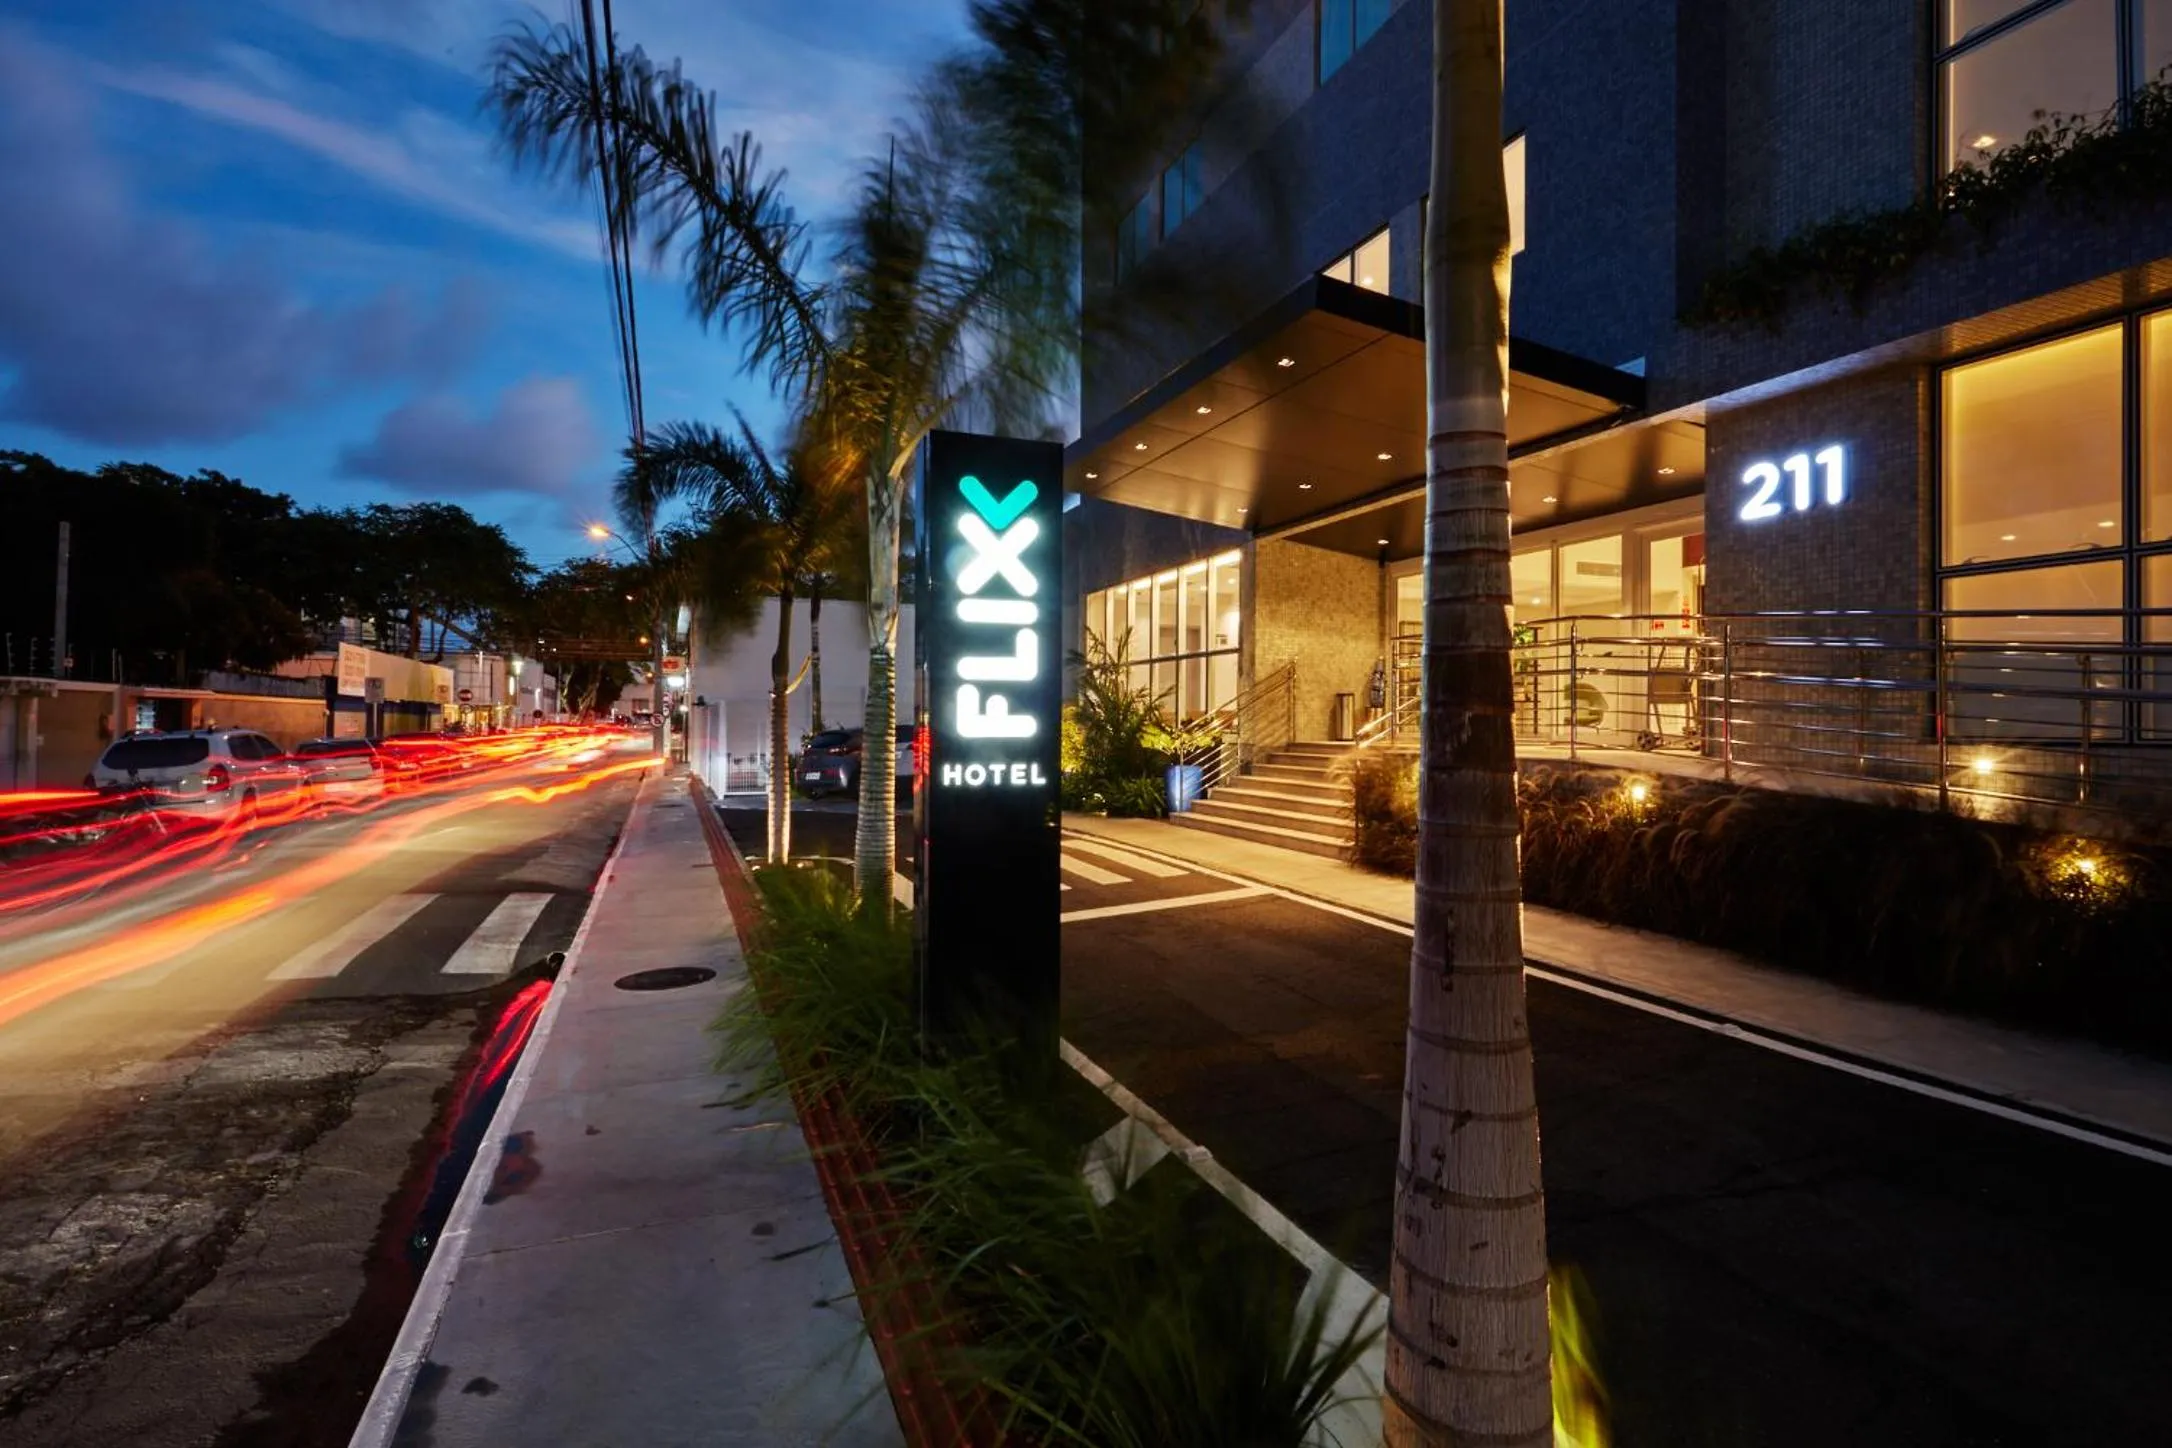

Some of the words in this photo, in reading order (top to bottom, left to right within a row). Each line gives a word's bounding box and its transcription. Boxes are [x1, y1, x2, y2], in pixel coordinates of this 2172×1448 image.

[1739, 444, 1843, 521] 211
[956, 512, 1039, 738] FLIX
[943, 762, 1046, 786] HOTEL
